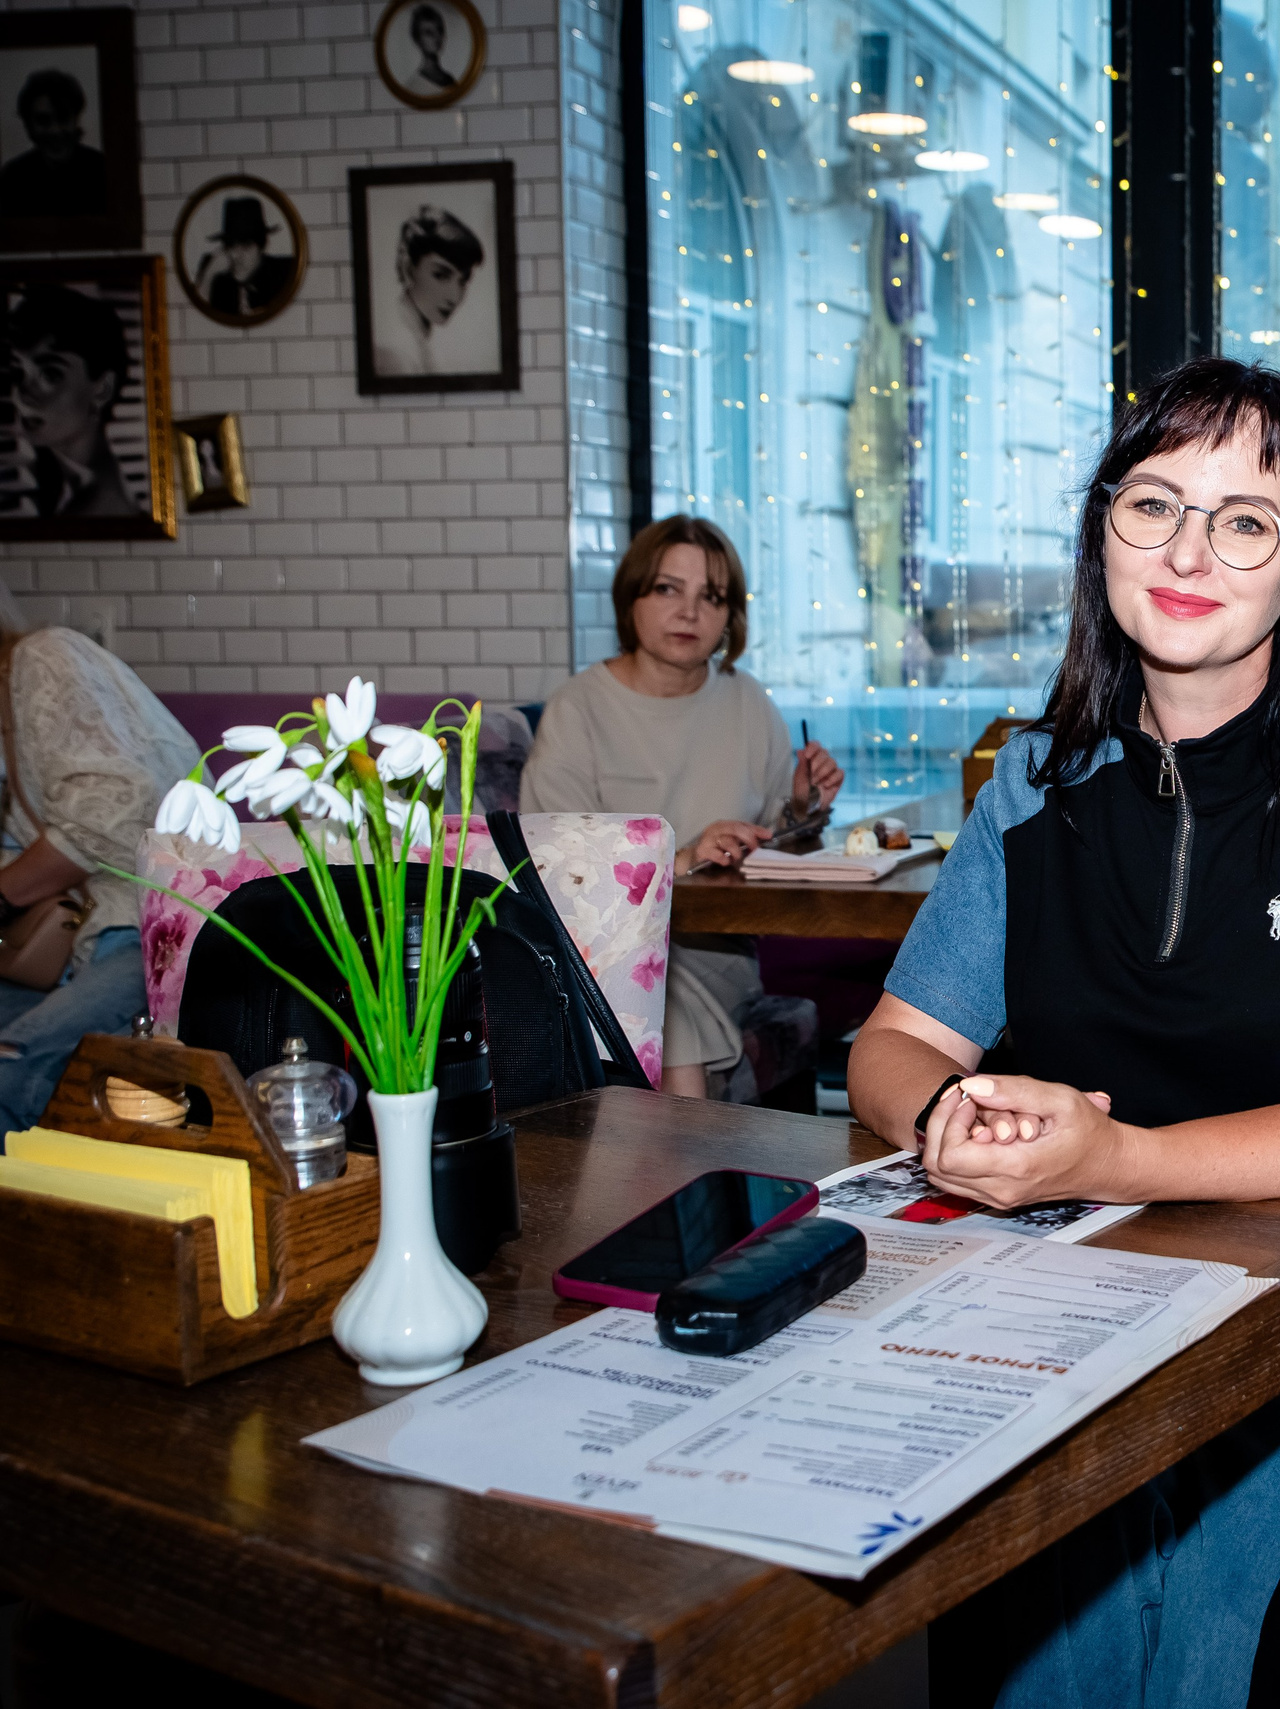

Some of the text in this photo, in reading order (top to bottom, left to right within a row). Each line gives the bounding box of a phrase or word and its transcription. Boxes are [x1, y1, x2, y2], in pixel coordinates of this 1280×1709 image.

[1060, 1311, 1133, 1326] ДОБАВКИ
[880, 1342, 961, 1360] МЕНЮ
[963, 1353, 1069, 1375] БАРНОЕ
